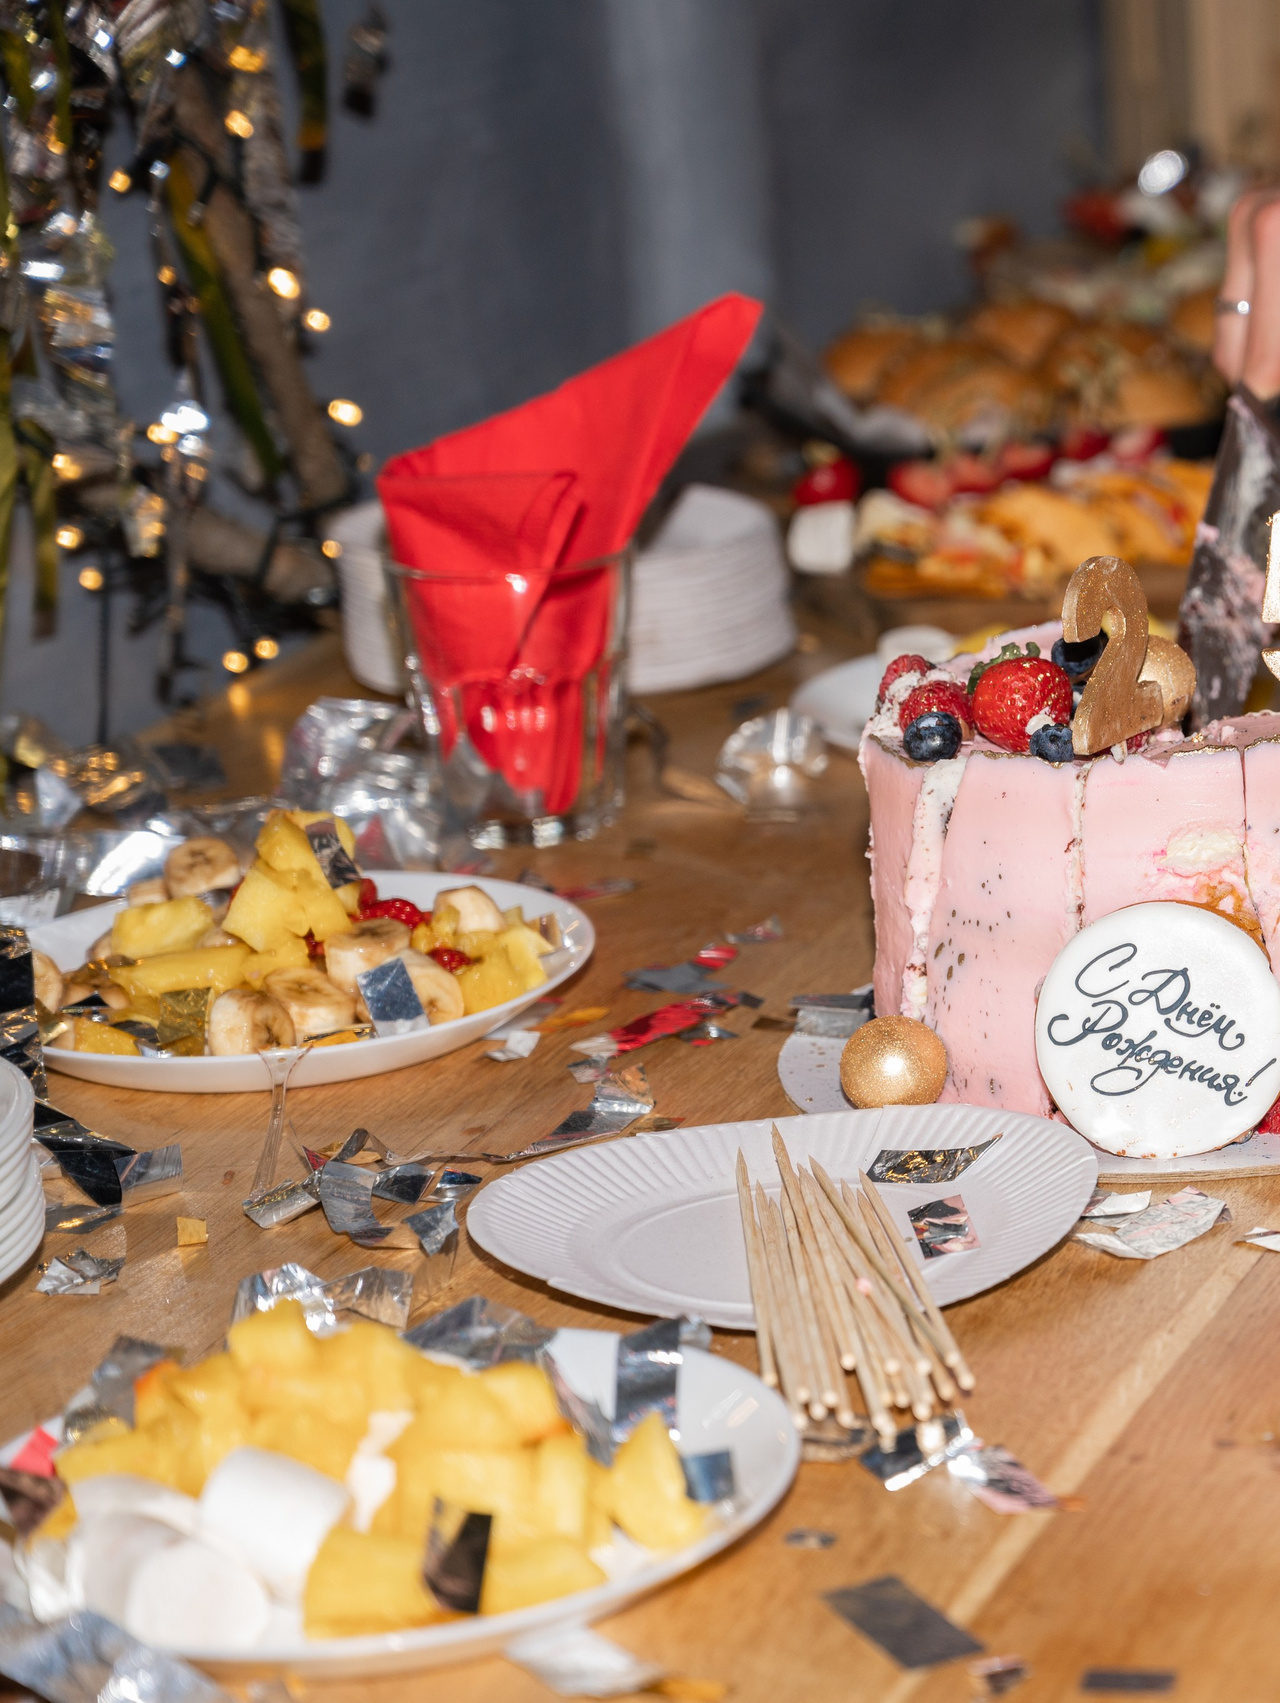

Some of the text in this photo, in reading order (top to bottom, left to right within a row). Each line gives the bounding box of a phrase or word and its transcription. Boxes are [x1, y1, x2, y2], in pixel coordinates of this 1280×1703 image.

[1074, 942, 1245, 1051] С Днём
[1047, 999, 1277, 1107] Рождения!
